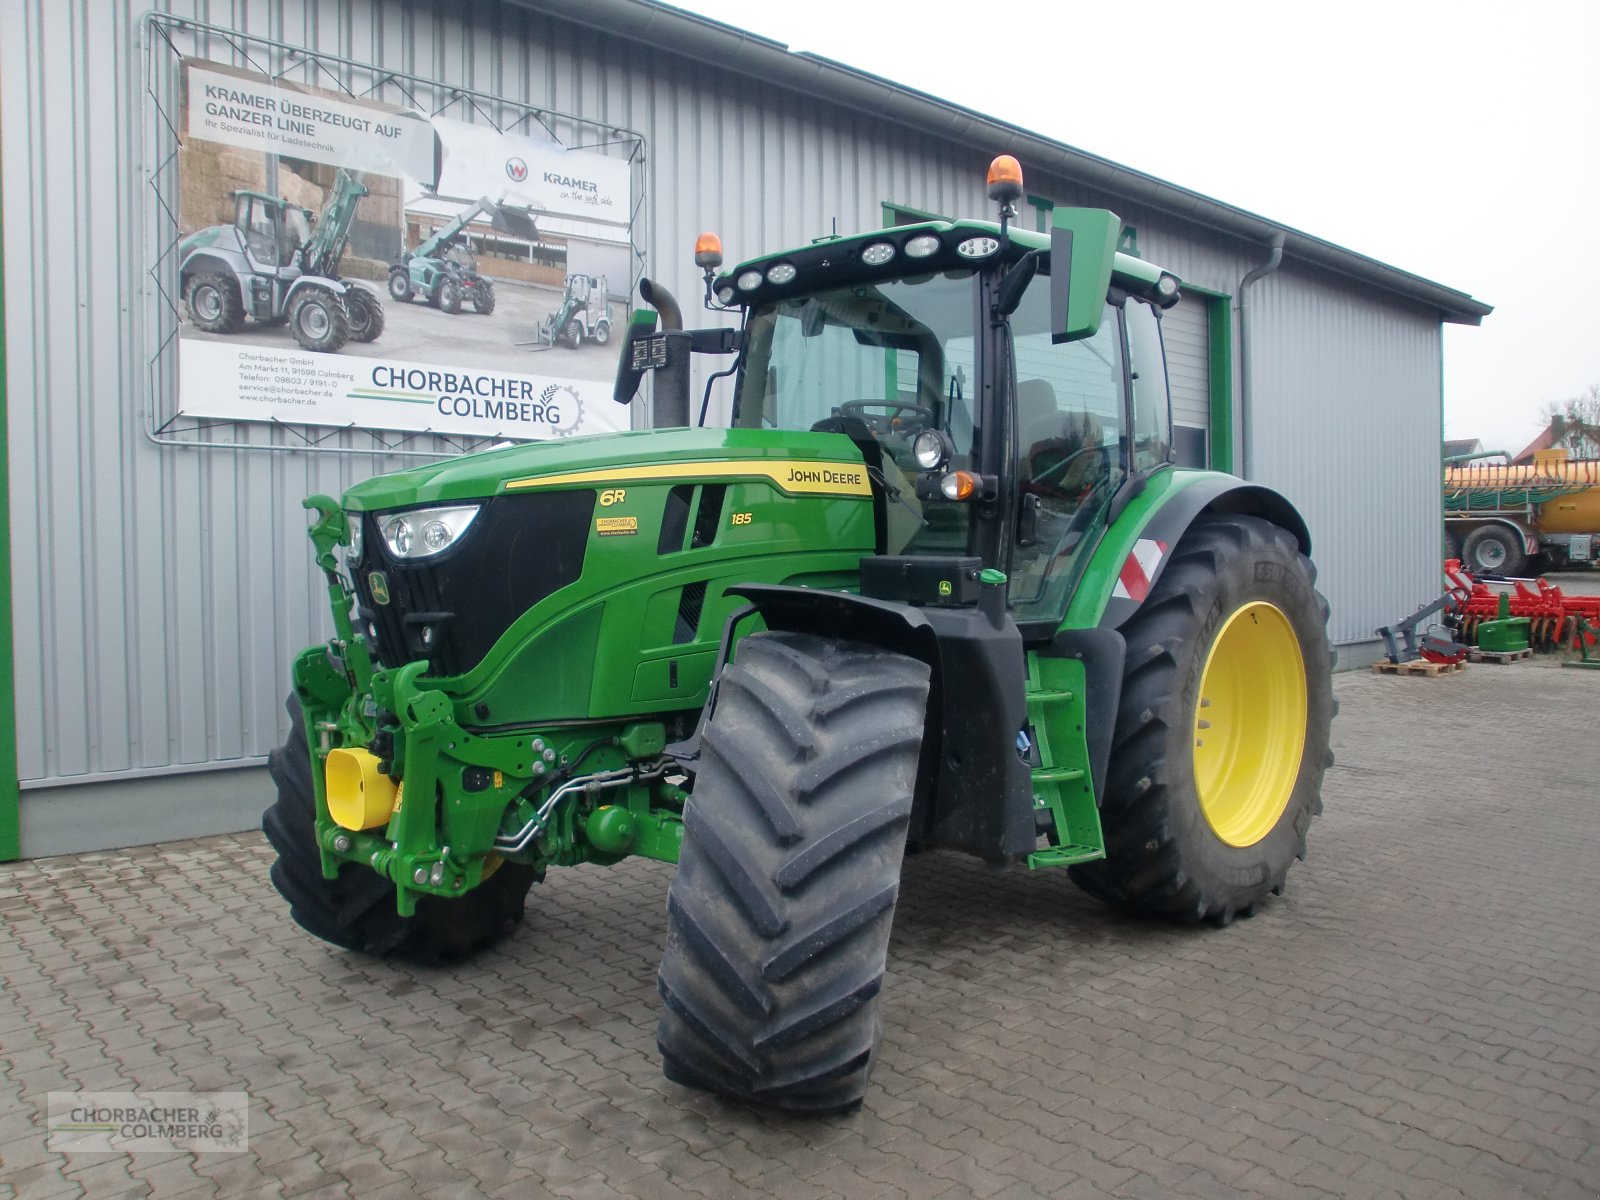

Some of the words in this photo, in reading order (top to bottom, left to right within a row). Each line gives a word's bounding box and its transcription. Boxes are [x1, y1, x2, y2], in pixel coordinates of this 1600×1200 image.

[205, 84, 276, 112] KRAMER
[280, 99, 371, 132] ÜBERZEUGT
[374, 123, 402, 139] AUF
[205, 102, 272, 129] GANZER
[277, 118, 315, 136] LINIE
[205, 118, 217, 129] Ihr
[220, 121, 265, 139] Spezialist
[267, 131, 279, 141] für
[281, 134, 335, 153] Ladetechnik
[543, 172, 598, 193] KRAMER
[238, 352, 288, 364] Chorbacher
[289, 357, 314, 366] GmbH
[239, 363, 253, 371] Am
[254, 364, 279, 373] Markt
[281, 366, 290, 375] 11,
[292, 367, 316, 376] 91598
[317, 369, 355, 382] Colmberg
[239, 371, 272, 383] Telefon:
[239, 384, 333, 398] service@chorbacher.de
[371, 365, 534, 401] CHORBACHER
[239, 395, 317, 406] www.chorbacher.de
[437, 395, 561, 425] COLMBERG
[787, 467, 821, 483] JOHN
[823, 469, 862, 485] DEERE
[600, 489, 626, 506] 6R
[731, 513, 753, 525] 185
